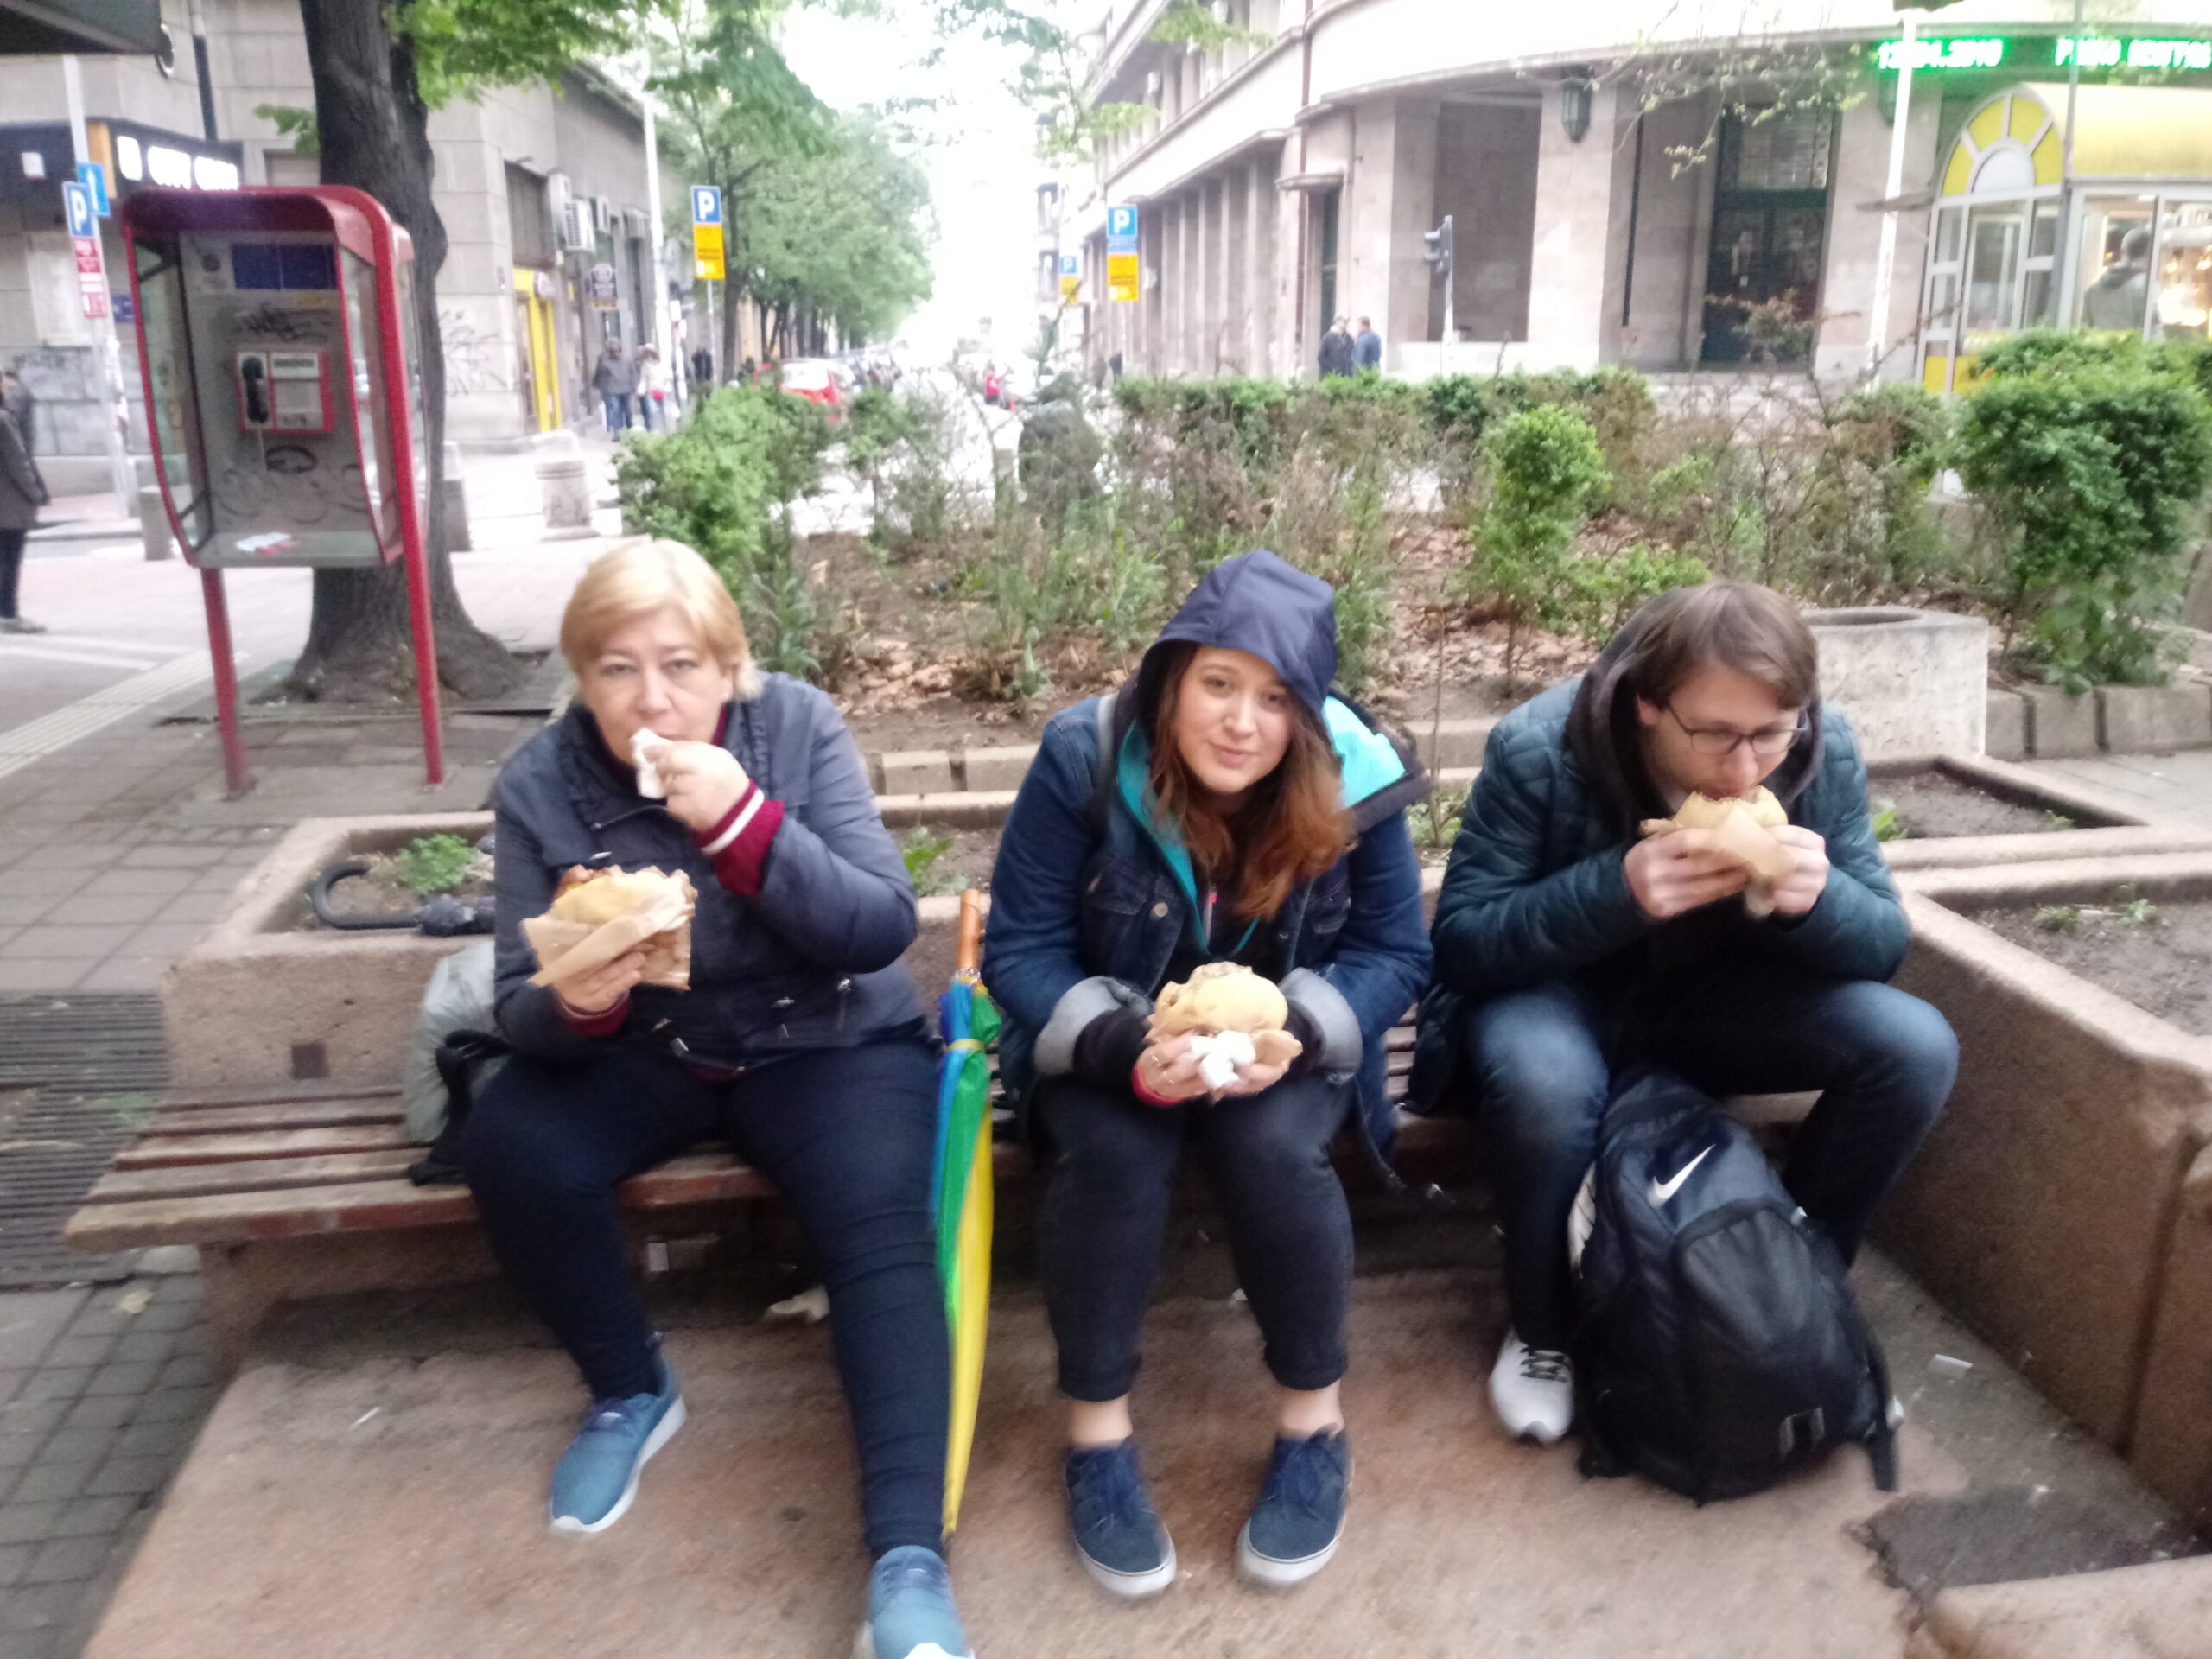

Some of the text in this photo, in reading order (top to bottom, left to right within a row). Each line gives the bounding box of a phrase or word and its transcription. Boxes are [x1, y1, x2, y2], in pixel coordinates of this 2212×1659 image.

[71, 189, 86, 232] P
[698, 191, 715, 219] P
[1114, 209, 1130, 233] P
[1063, 257, 1074, 272] P
